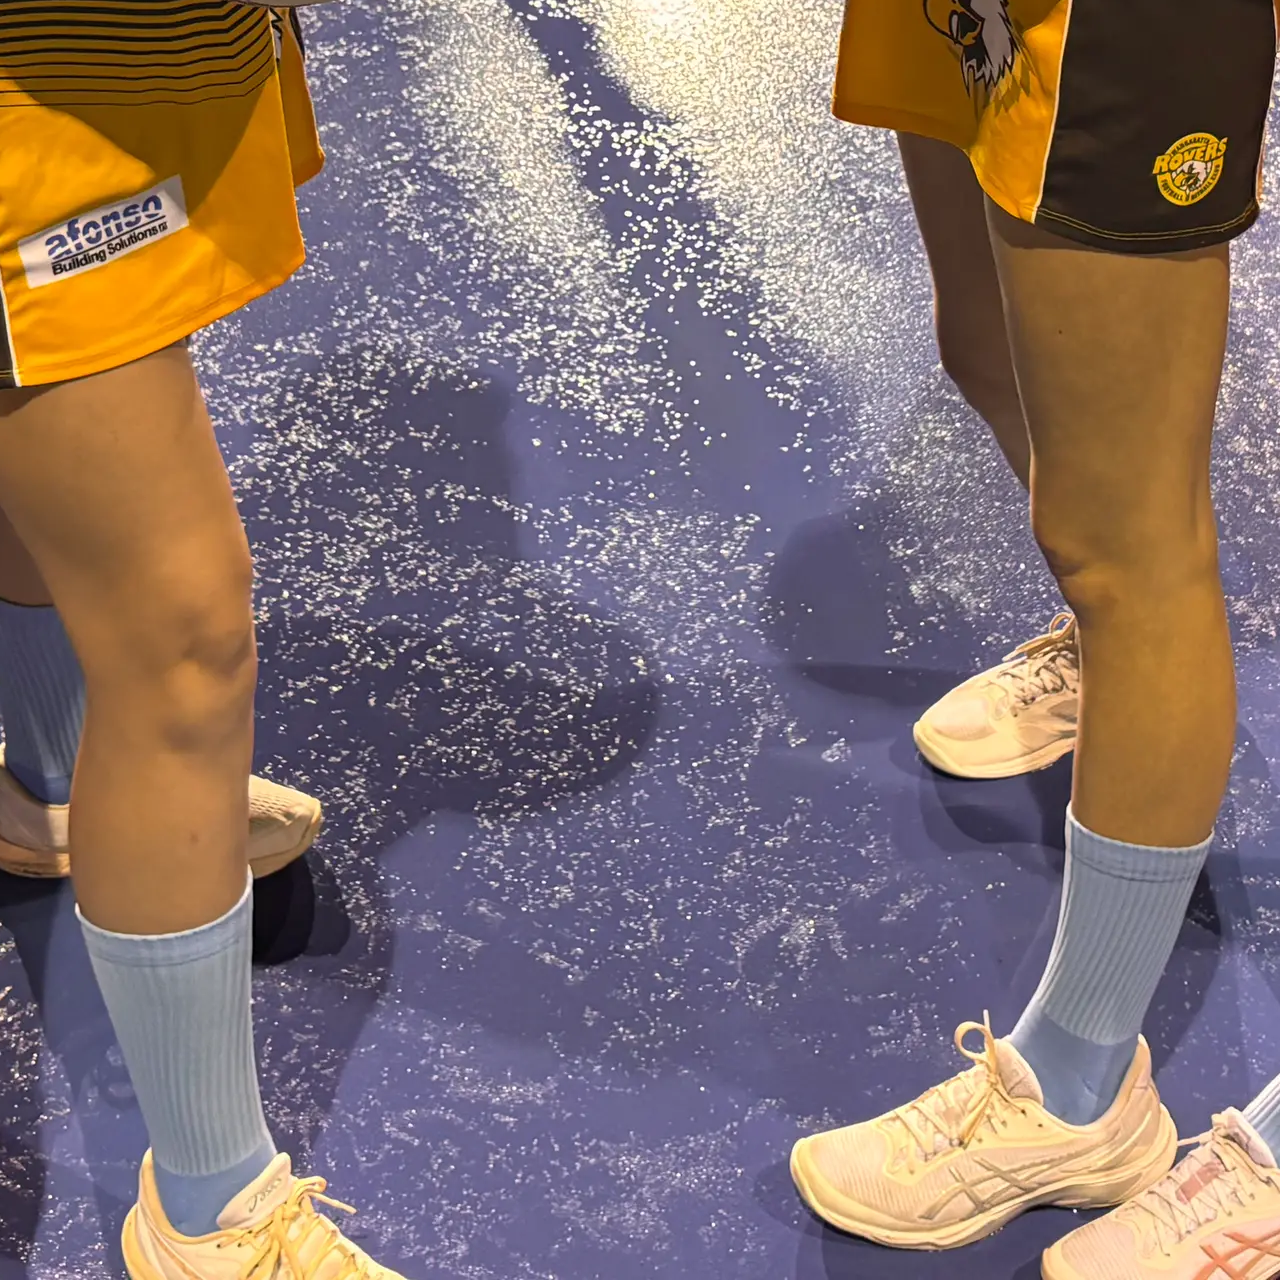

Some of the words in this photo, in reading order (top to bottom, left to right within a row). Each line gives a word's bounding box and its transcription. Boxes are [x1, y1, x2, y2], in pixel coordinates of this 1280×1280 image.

[1152, 136, 1228, 176] ROVERS
[45, 194, 163, 260] afonso
[51, 249, 107, 276] Building
[108, 224, 158, 255] Solutions
